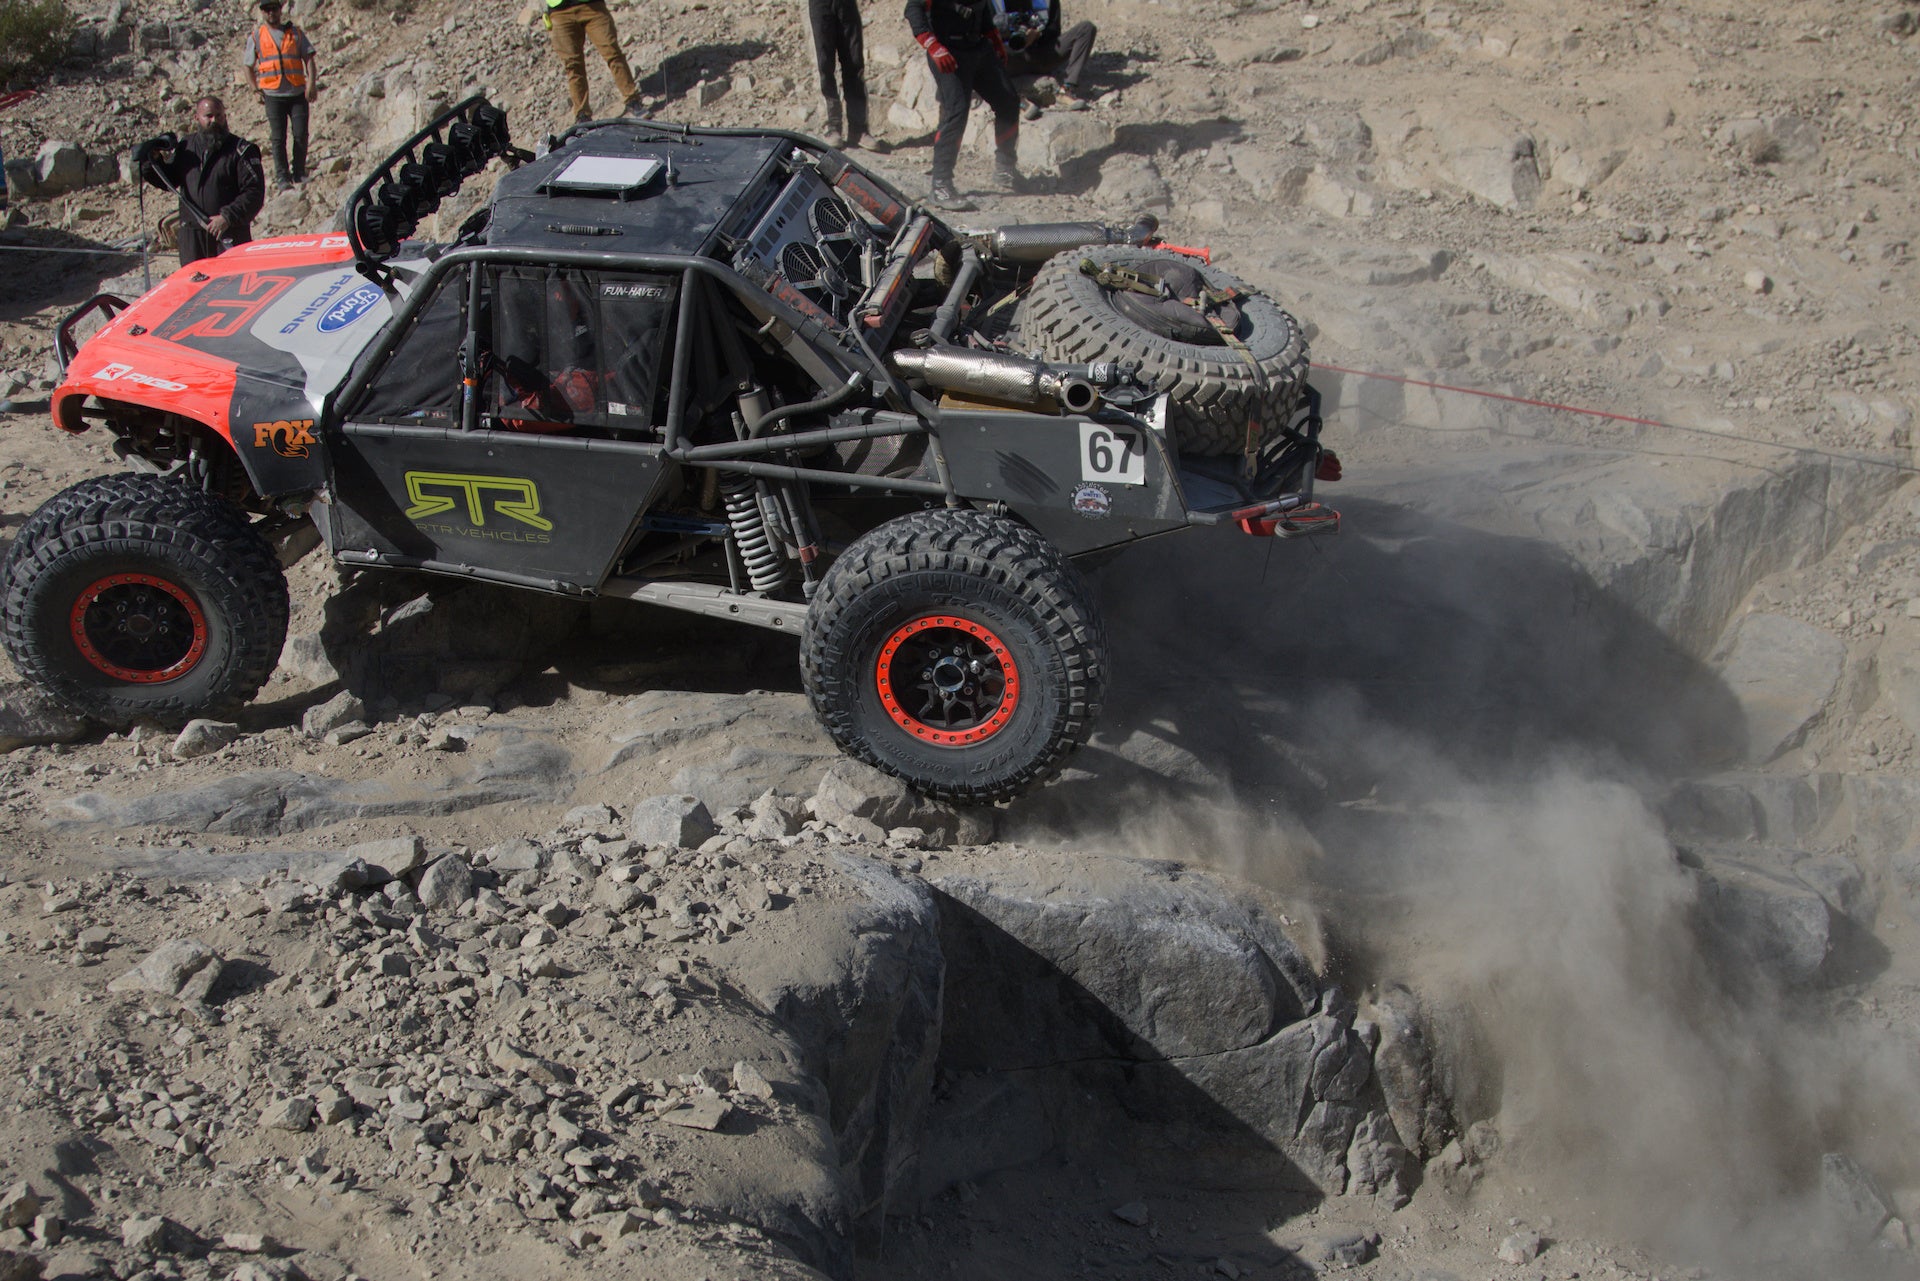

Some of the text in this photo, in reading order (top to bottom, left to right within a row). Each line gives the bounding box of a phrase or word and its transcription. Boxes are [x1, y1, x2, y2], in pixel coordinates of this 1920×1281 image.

[280, 274, 354, 334] RACING
[604, 286, 663, 297] FUN-HAVER
[253, 420, 316, 459] FOX
[1089, 431, 1137, 474] 67
[415, 523, 551, 544] RTR VEHICLES
